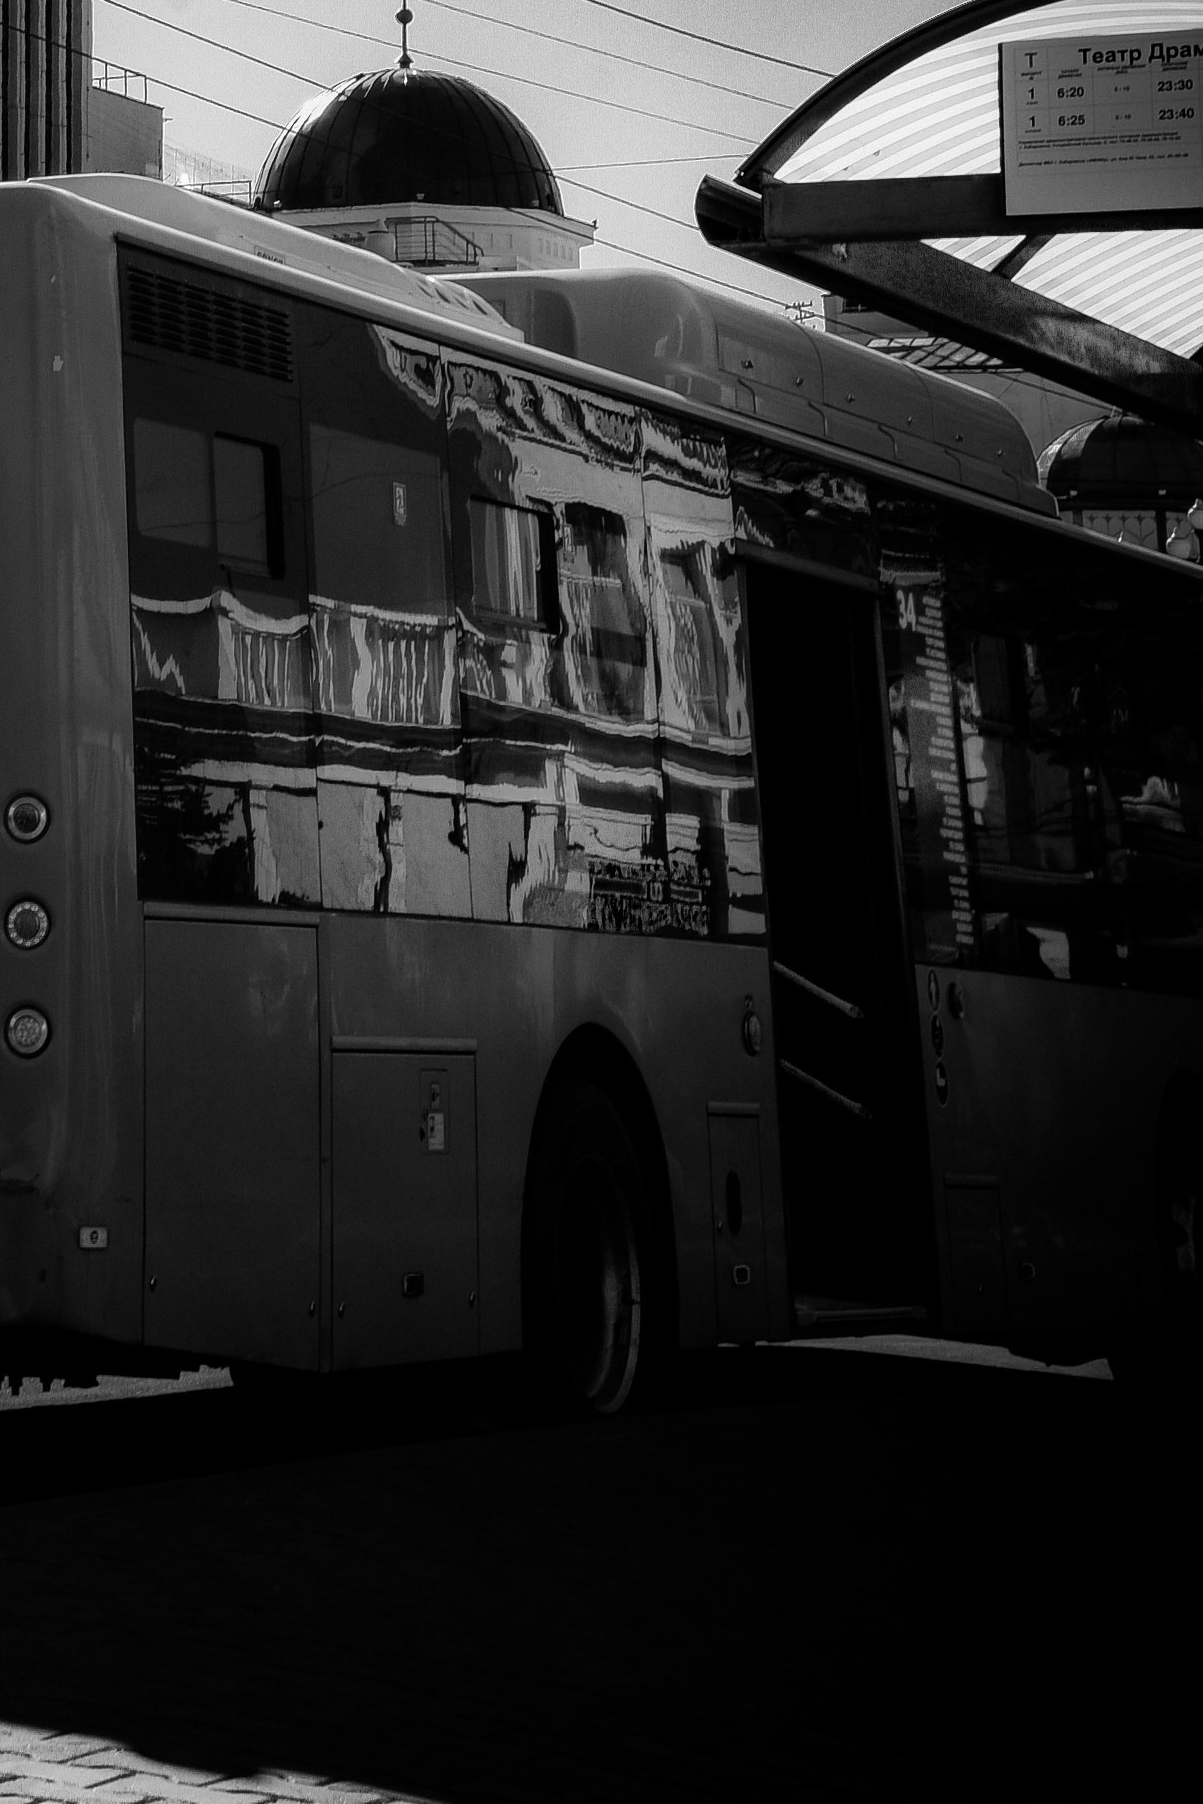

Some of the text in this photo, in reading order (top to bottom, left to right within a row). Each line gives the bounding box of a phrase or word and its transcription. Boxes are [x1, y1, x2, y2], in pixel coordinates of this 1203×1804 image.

[1078, 48, 1142, 66] Театр
[1028, 79, 1194, 100] 1 6:20 23:30
[1029, 107, 1195, 128] 1 6:25 23:40
[896, 589, 916, 632] 34
